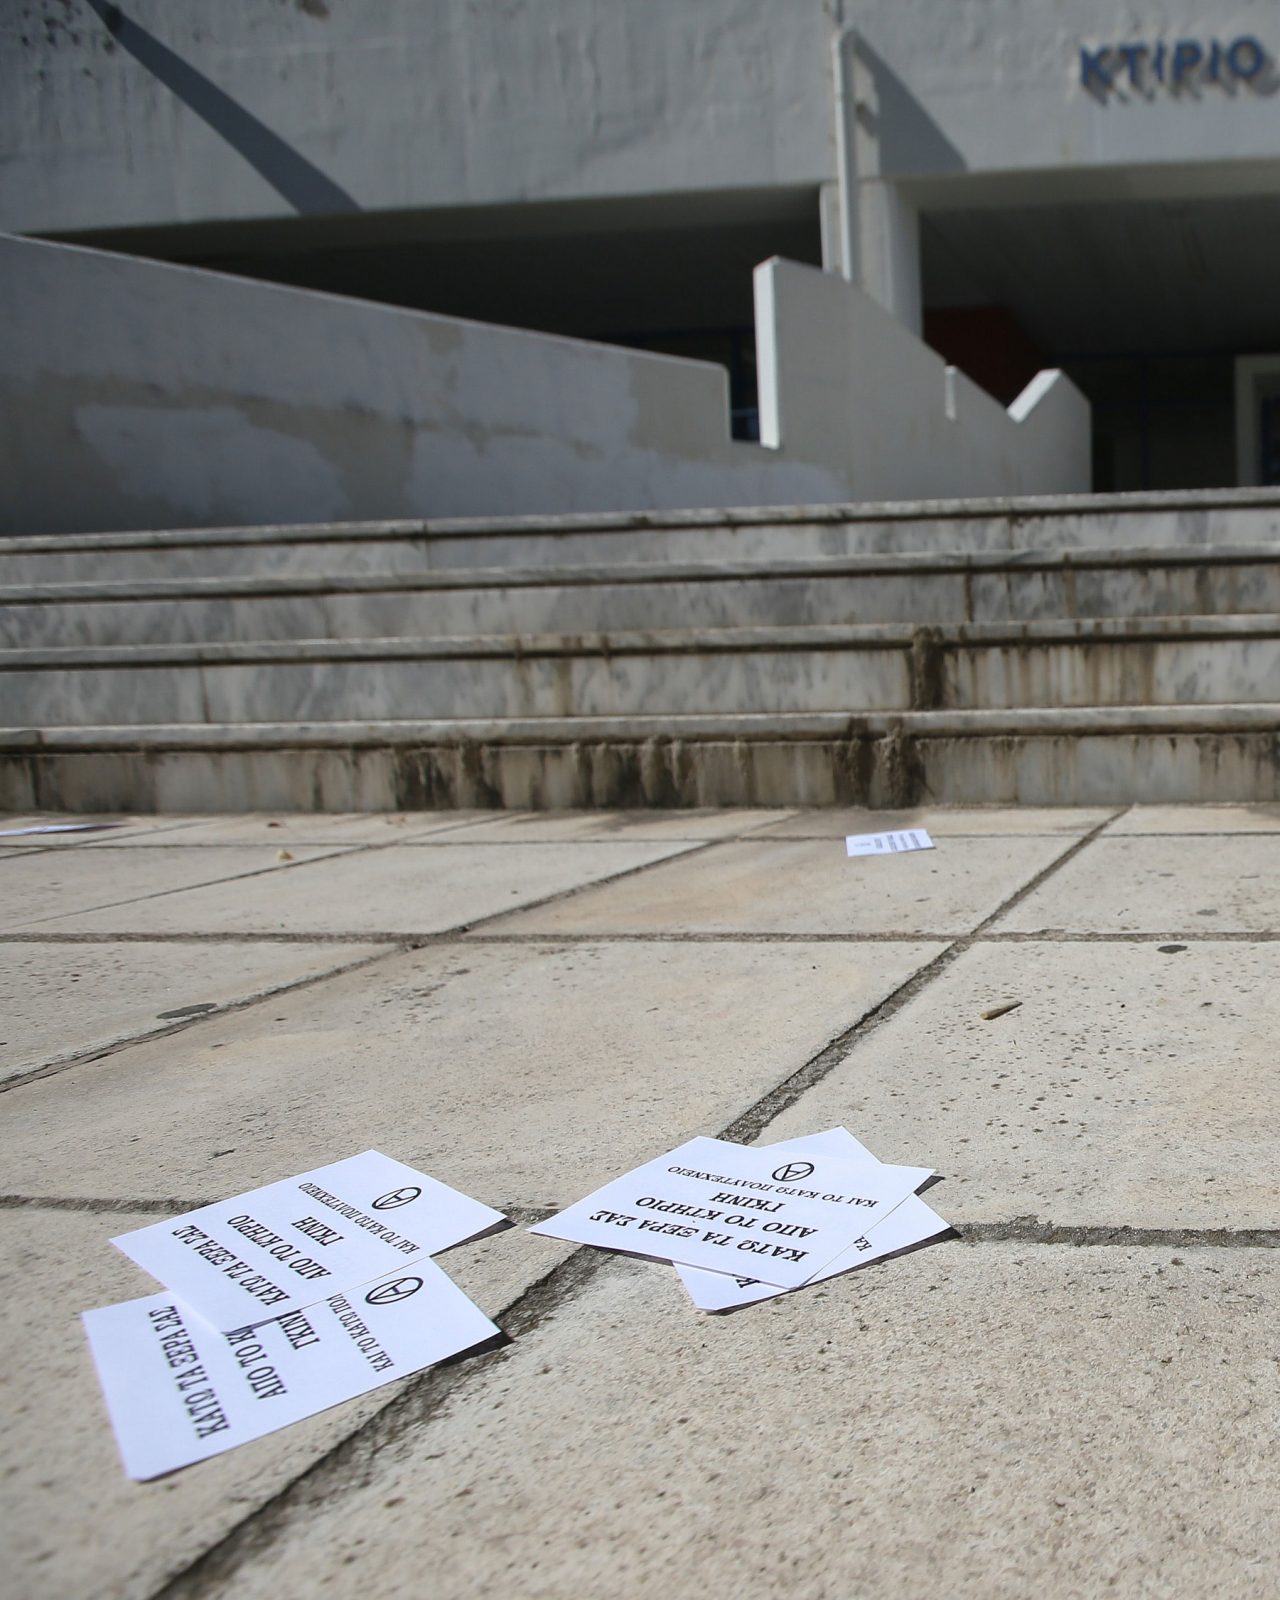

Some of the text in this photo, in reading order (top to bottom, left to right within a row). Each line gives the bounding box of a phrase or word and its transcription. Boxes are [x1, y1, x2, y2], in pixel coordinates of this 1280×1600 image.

[1080, 36, 1264, 87] ΚΤΙΡΙΟ
[667, 1166, 879, 1208] ΚΑΙ ΤΟ ΚΑΤΩ ΠΟΛΥΤΕΧΝΕΙΟ
[708, 1192, 786, 1213] ΓΚΙΝΗ
[290, 1216, 345, 1247] ΓΚΙΝΗ
[298, 1182, 420, 1255] ΚΑΙ ΤΟ ΚΑΤΩ ΠΟΛΥΤΕΧΝΕΙΟ
[589, 1210, 810, 1263] ΚΑΤΩ ΤΑ ΞΕΡΑ ΣΑΣ
[635, 1197, 819, 1238] ΑΠΟ ΤΟ ΚΤΗΡΙΟ
[171, 1224, 291, 1306] ΚΑΤΩ ΤΑ ΞΕΡΑ ΣΑΣ
[226, 1215, 332, 1280] ΑΠΟ ΤΟ ΚΤΗΡΙΟ
[338, 1311, 371, 1340] ΚΑΤΩ
[356, 1337, 380, 1354] ΤΟ
[148, 1305, 231, 1439] ΚΑΤΩ ΤΑ ΞΕΡΑ ΣΑΣ
[235, 1344, 268, 1368] ΤΟ
[365, 1350, 395, 1373] ΚΑΙ
[247, 1366, 288, 1400] ΑΠΟ
